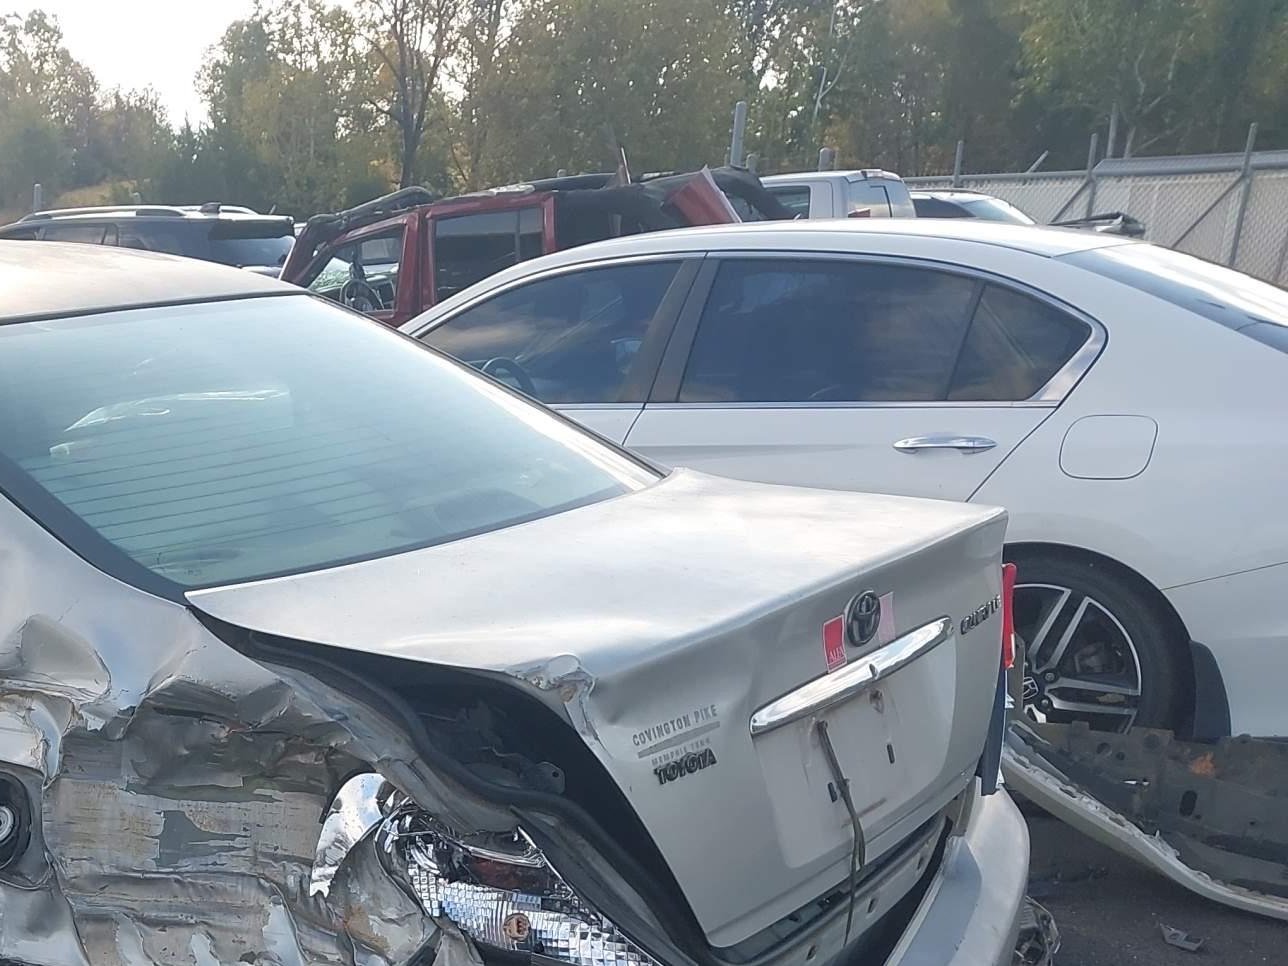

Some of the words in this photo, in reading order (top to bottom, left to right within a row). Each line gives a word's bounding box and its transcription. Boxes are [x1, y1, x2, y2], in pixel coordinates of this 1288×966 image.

[632, 714, 691, 746] COVINGTON
[693, 704, 717, 723] PIKE
[653, 748, 717, 785] TOYOTA
